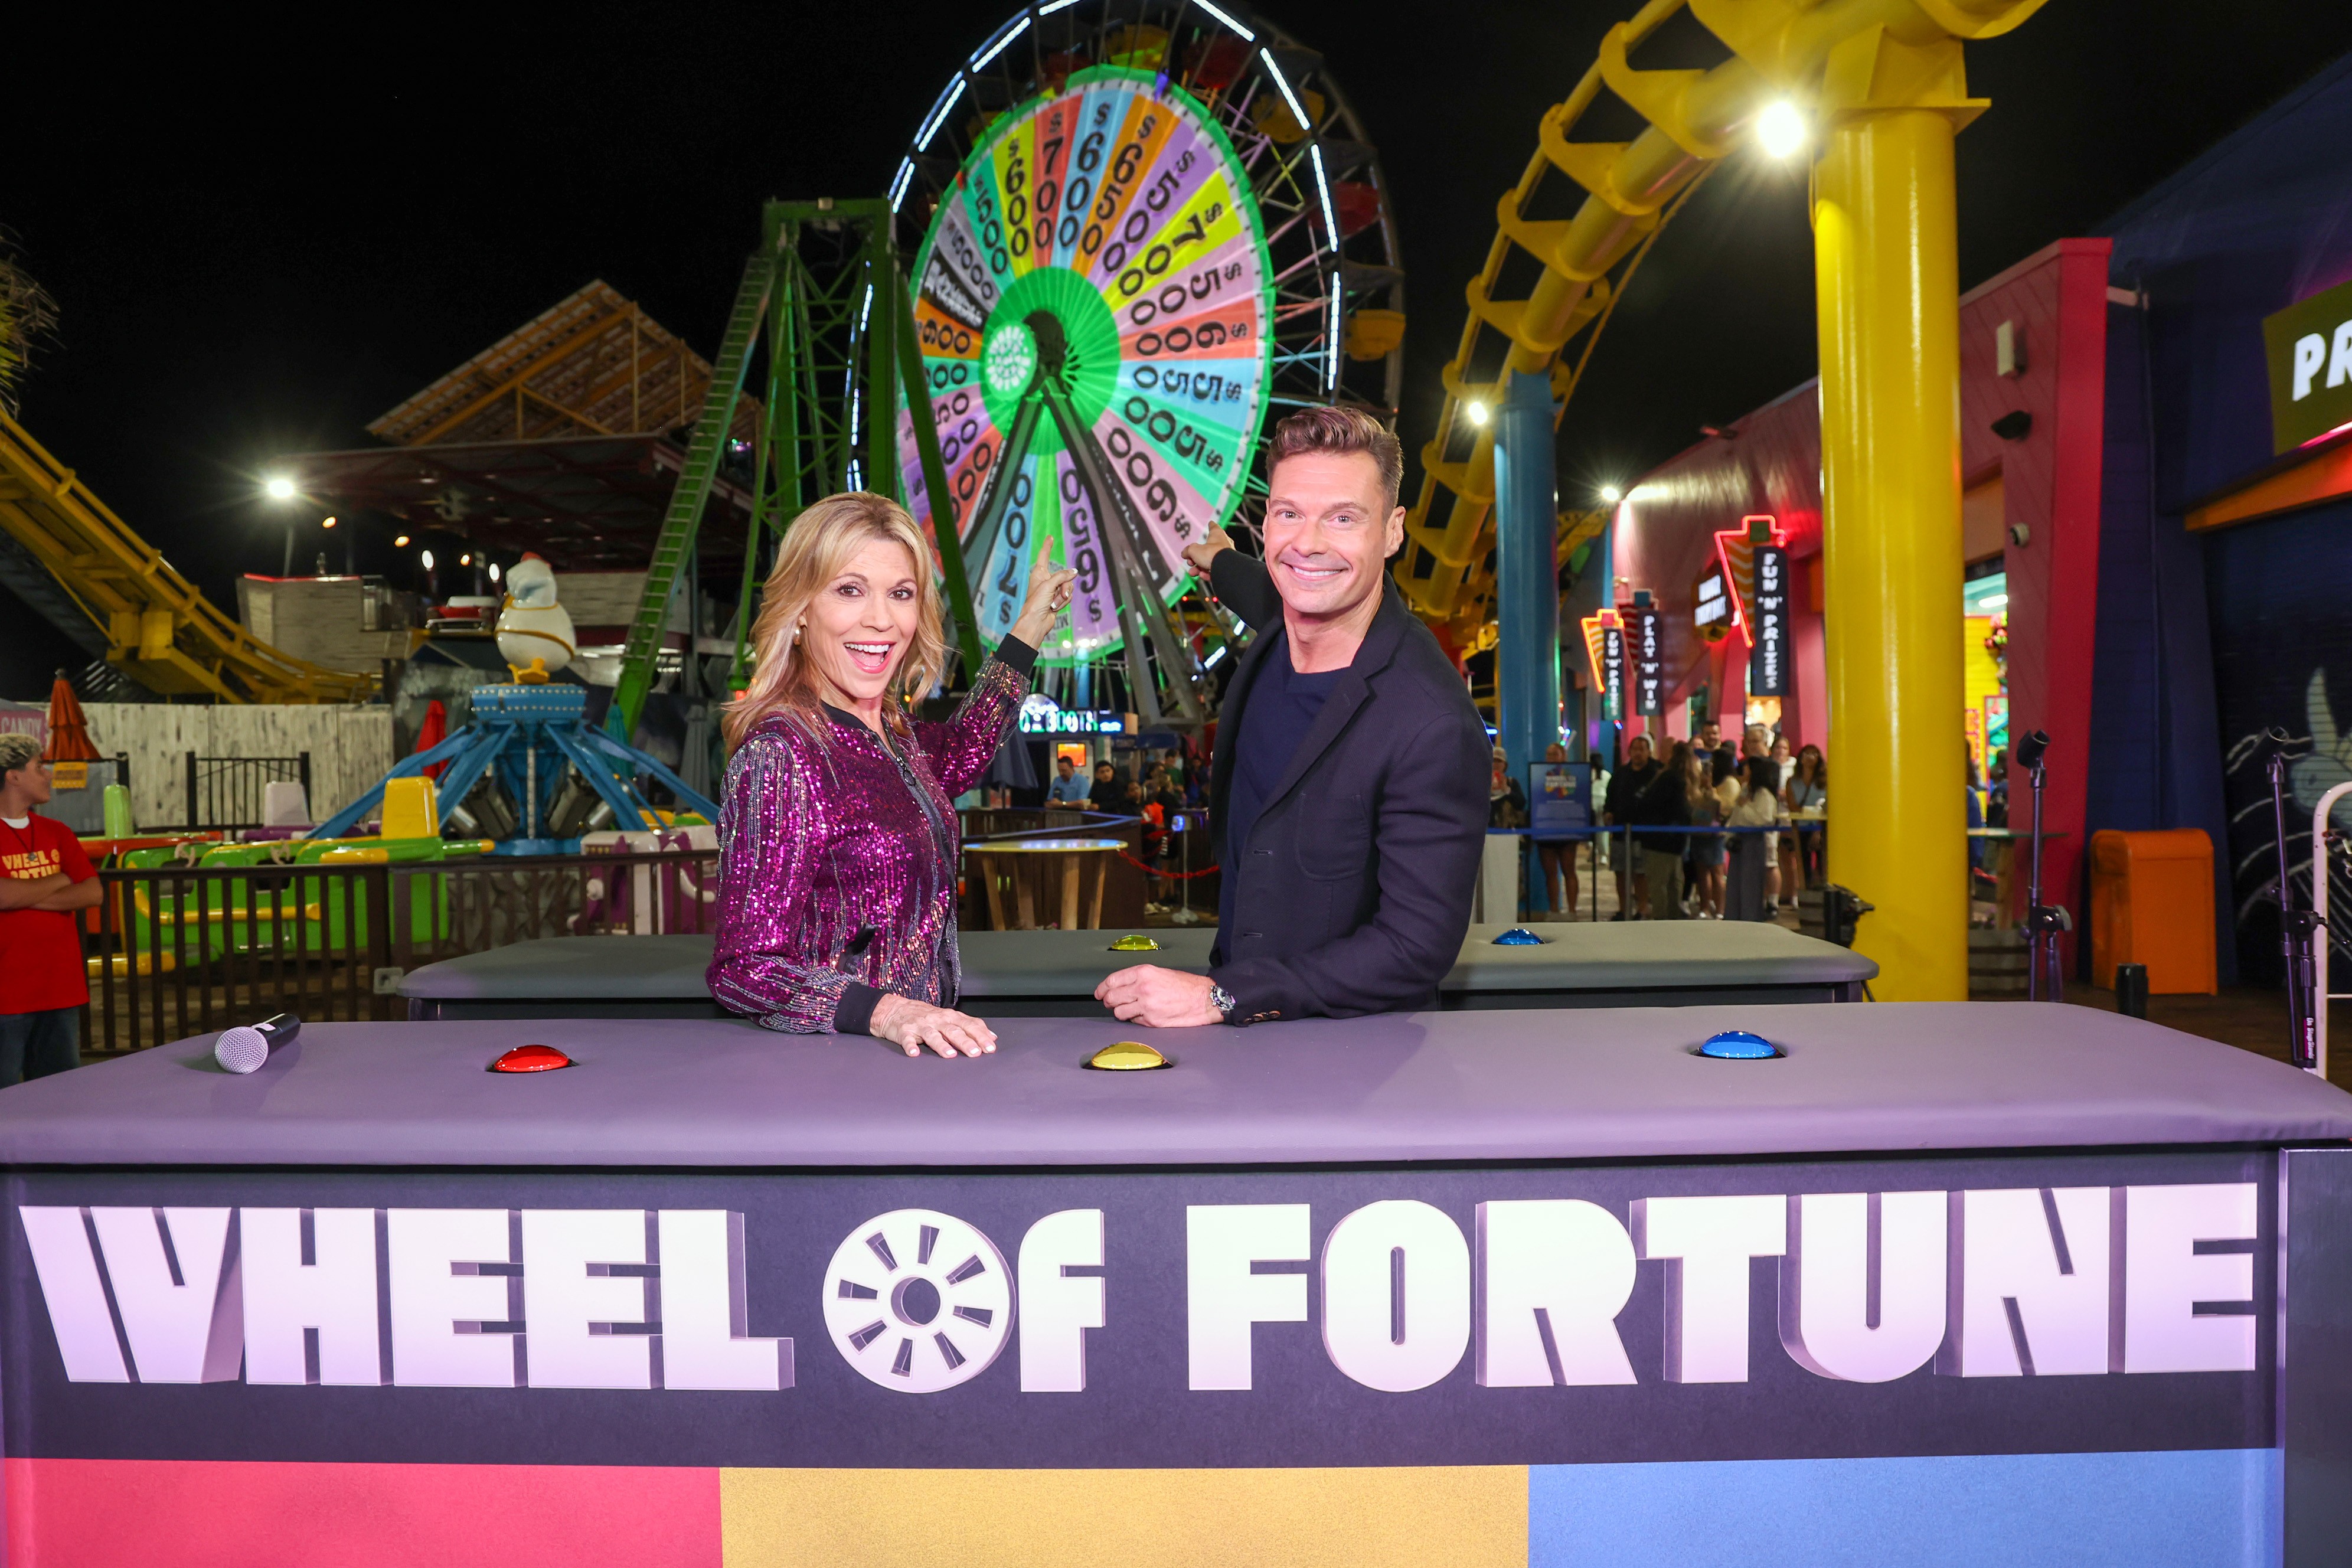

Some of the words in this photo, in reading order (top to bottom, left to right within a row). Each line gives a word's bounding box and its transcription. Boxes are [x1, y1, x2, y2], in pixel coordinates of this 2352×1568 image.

[1005, 138, 1029, 257] $600
[1035, 112, 1063, 249] $700
[1059, 103, 1111, 247] $600
[1081, 114, 1157, 255] $650
[1103, 150, 1196, 273] $500
[975, 174, 1008, 275] $500
[1118, 201, 1225, 296] $700
[1130, 261, 1243, 326] $500
[1136, 321, 1247, 355] $600
[1133, 364, 1242, 401] $550
[1106, 427, 1191, 540] $600
[1124, 396, 1225, 473] $500
[998, 474, 1031, 624] $700
[1061, 469, 1103, 622] $650
[1762, 553, 1778, 592] FUN
[1607, 631, 1619, 656] FUN
[1644, 615, 1655, 658] PLAY
[1762, 614, 1779, 690] PRIZES
[1643, 679, 1658, 710] WIN
[19, 1206, 794, 1391] WHEEL
[1185, 1182, 2258, 1393] FORTUNE
